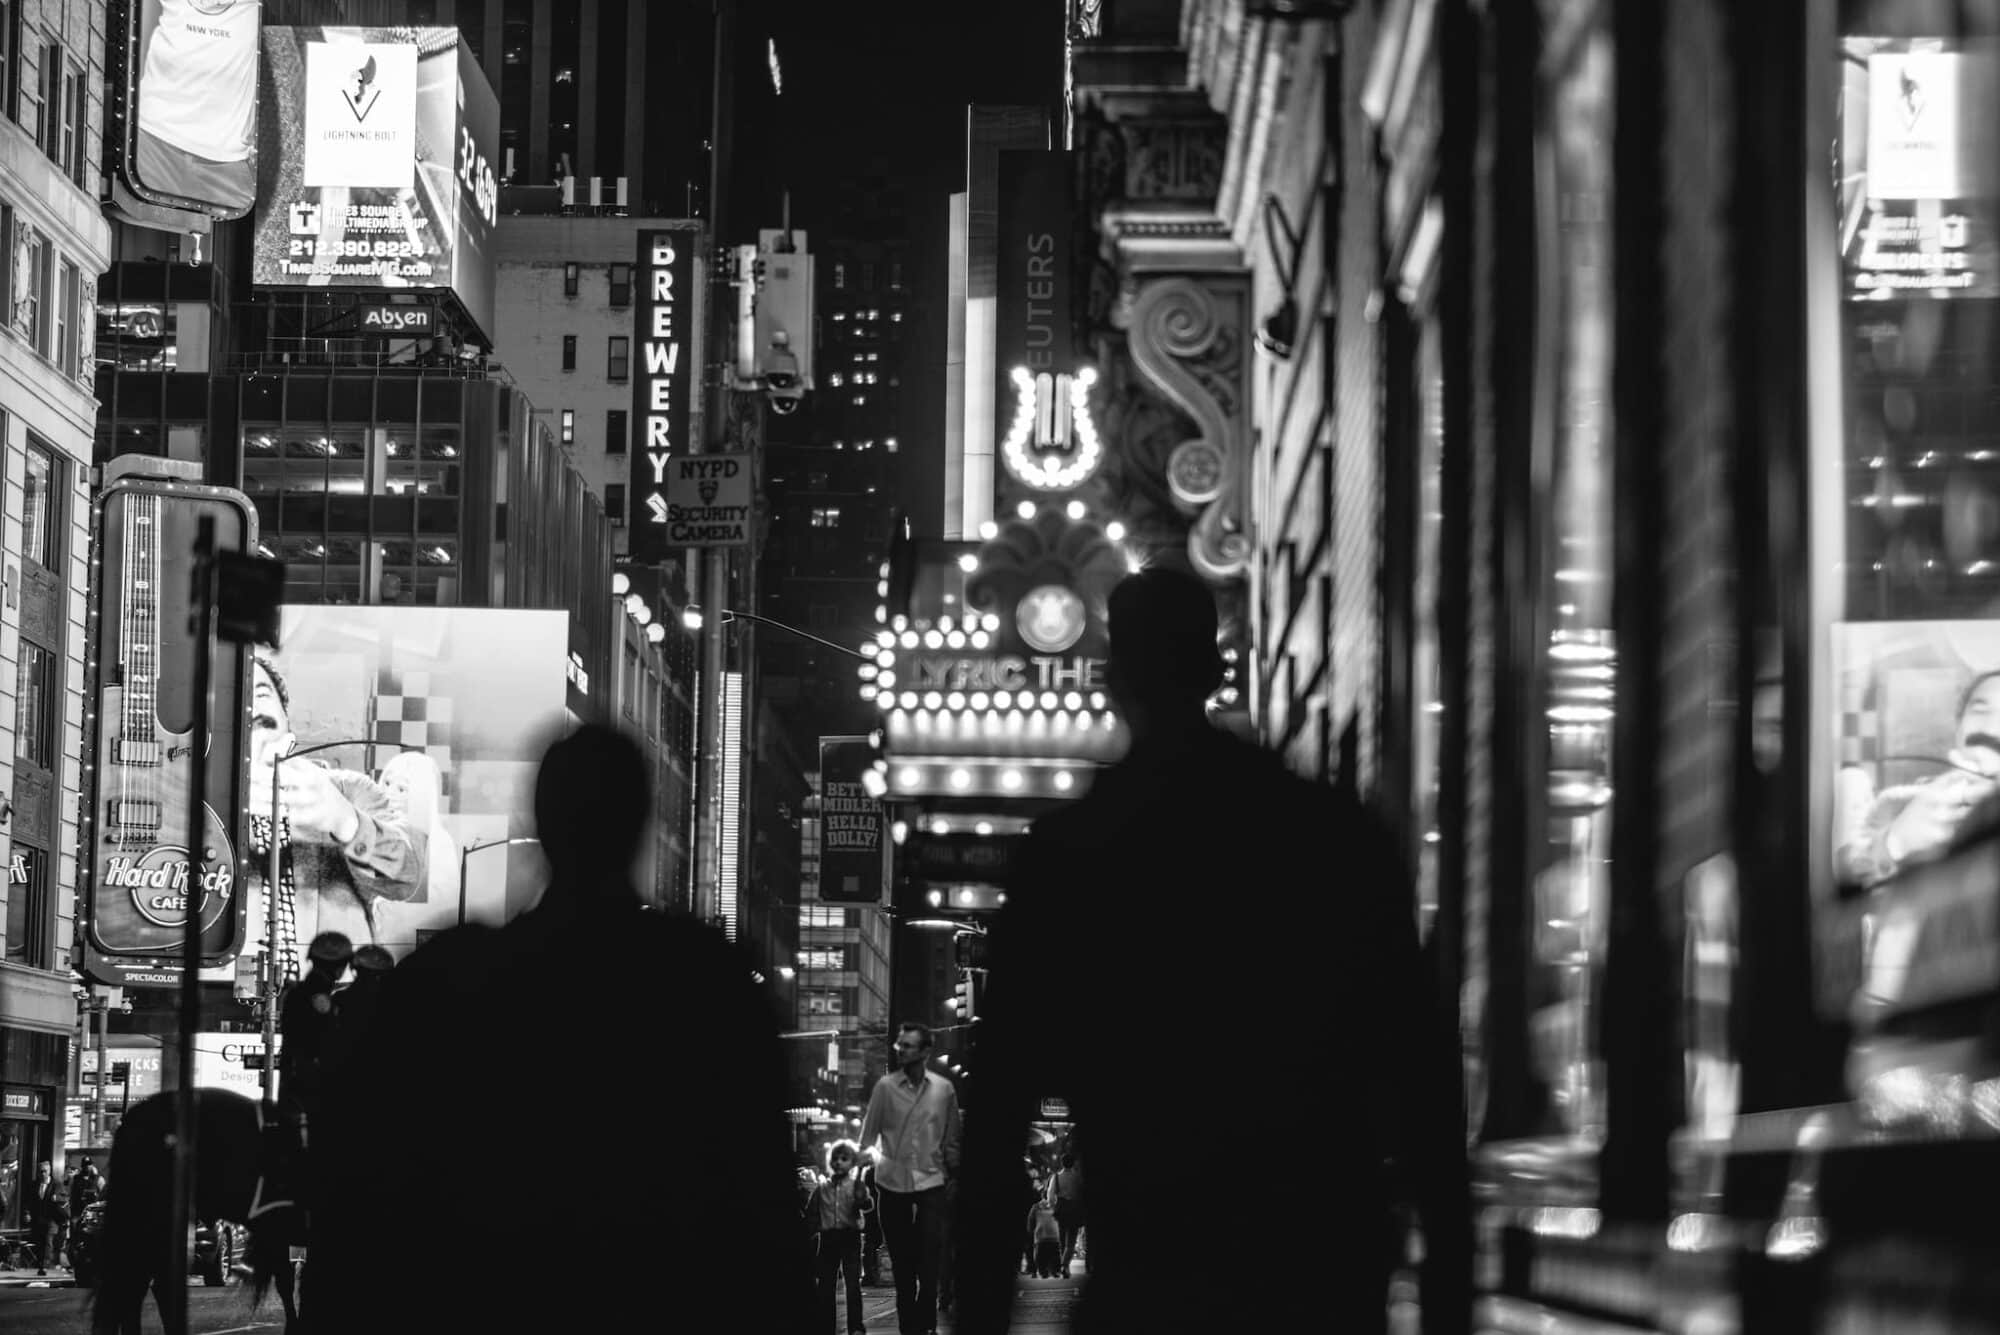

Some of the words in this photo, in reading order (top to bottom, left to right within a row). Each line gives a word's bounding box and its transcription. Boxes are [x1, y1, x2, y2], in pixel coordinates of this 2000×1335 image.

[186, 23, 206, 35] NEW
[208, 28, 232, 39] YORK
[322, 129, 371, 141] LIGHTNING
[374, 129, 397, 141] BOLT
[289, 239, 424, 257] 212.390.8224
[365, 307, 428, 329] Absen
[645, 234, 679, 483] BREWERY
[680, 459, 738, 479] NYPD
[668, 503, 749, 522] SECURITY
[670, 522, 744, 541] CAMERA
[908, 656, 1027, 691] LYRIC
[823, 797, 882, 812] MIDLER
[827, 831, 878, 848] DOLLY!
[105, 857, 171, 888] Hard
[172, 860, 231, 899] Rck
